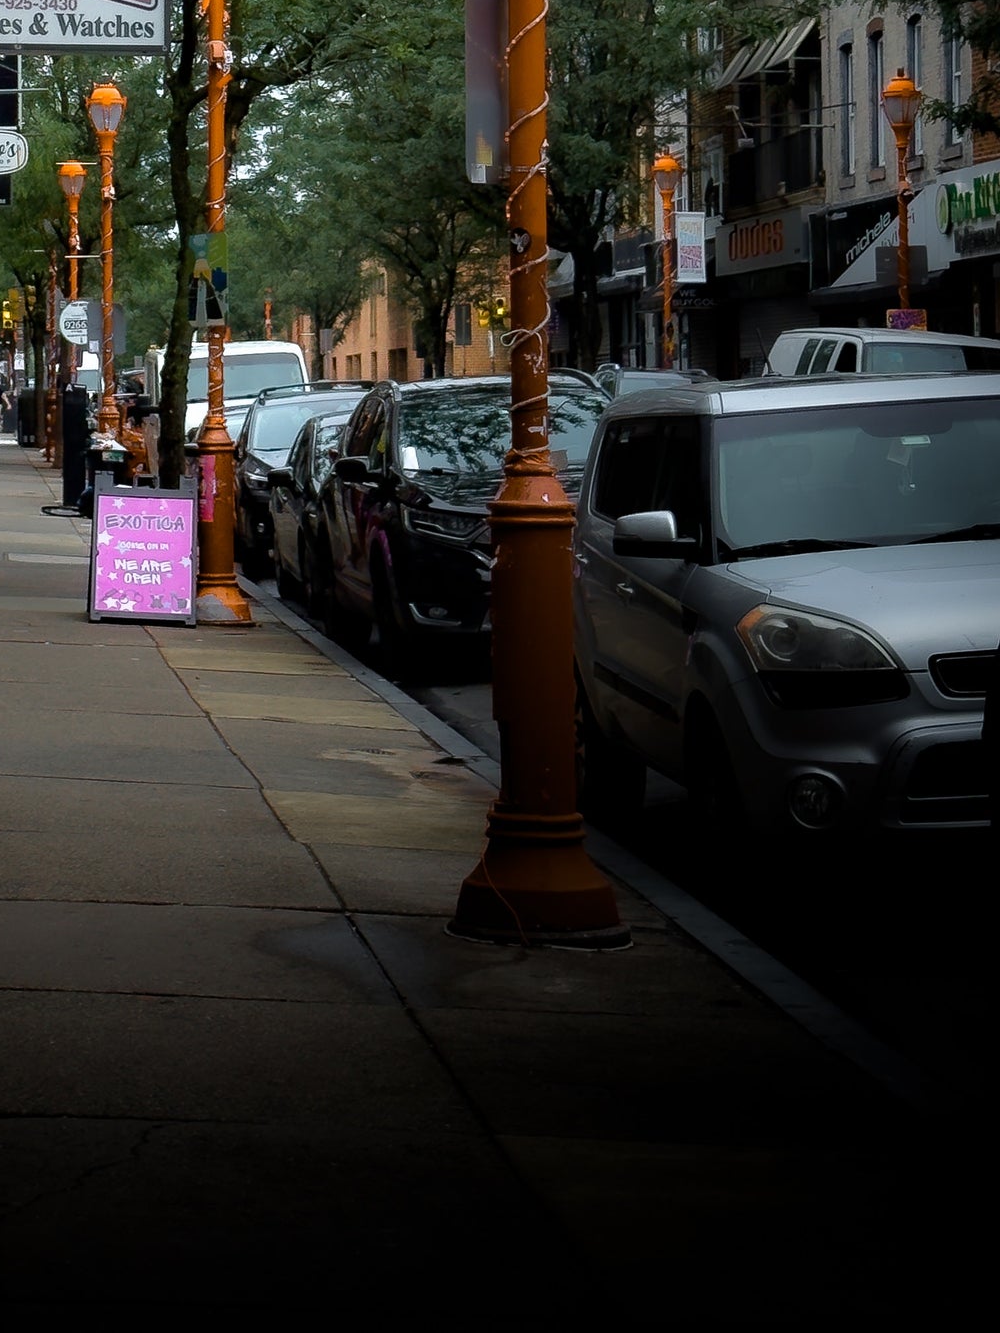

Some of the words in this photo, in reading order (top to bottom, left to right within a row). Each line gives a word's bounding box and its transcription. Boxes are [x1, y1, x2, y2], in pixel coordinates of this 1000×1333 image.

[28, 12, 49, 36] &
[54, 13, 155, 39] Watches
[728, 218, 784, 262] dudes
[845, 211, 892, 266] michele
[105, 514, 185, 532] EXOTICA
[114, 558, 138, 571] WE
[140, 559, 172, 573] ARE
[124, 572, 162, 585] OPEN
